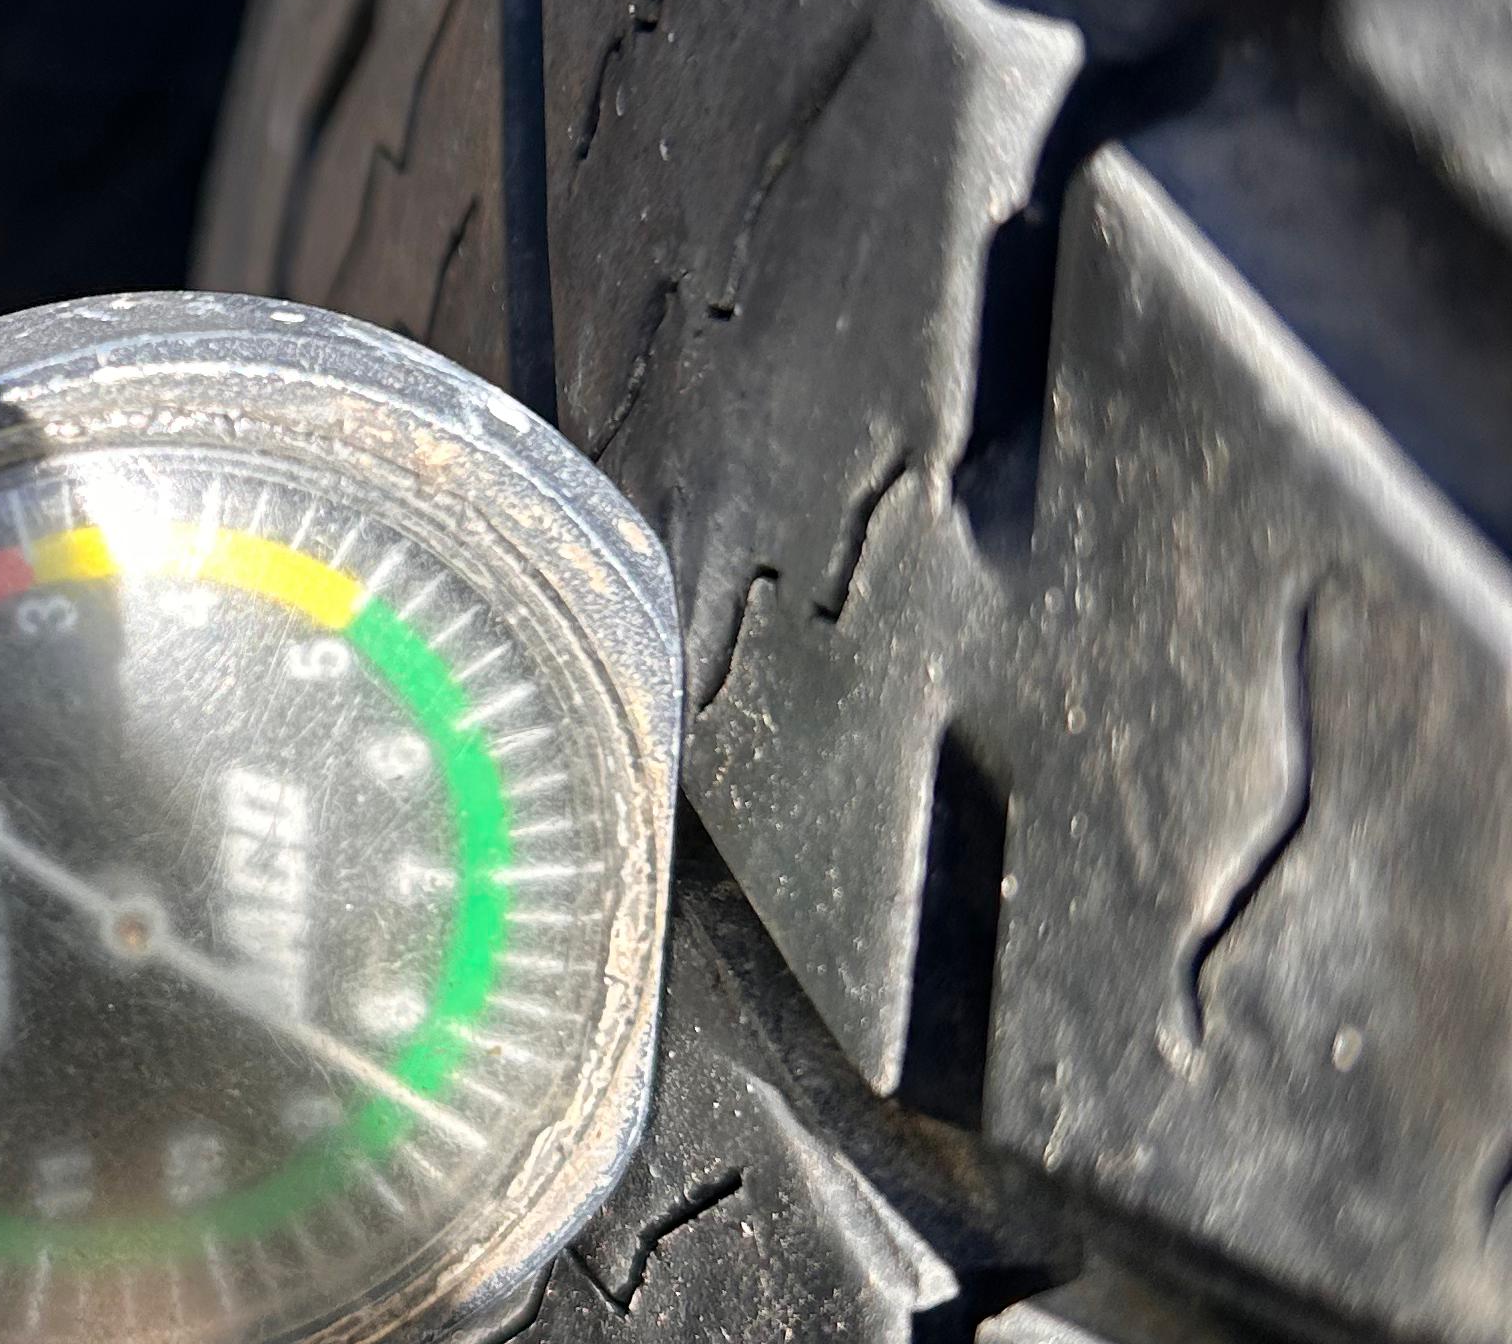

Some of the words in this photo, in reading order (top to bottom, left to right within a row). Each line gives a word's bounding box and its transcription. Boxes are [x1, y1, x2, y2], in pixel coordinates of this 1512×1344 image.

[18, 595, 79, 634] 3
[287, 639, 350, 680] 5
[360, 735, 432, 780] 6
[394, 859, 456, 902] 7
